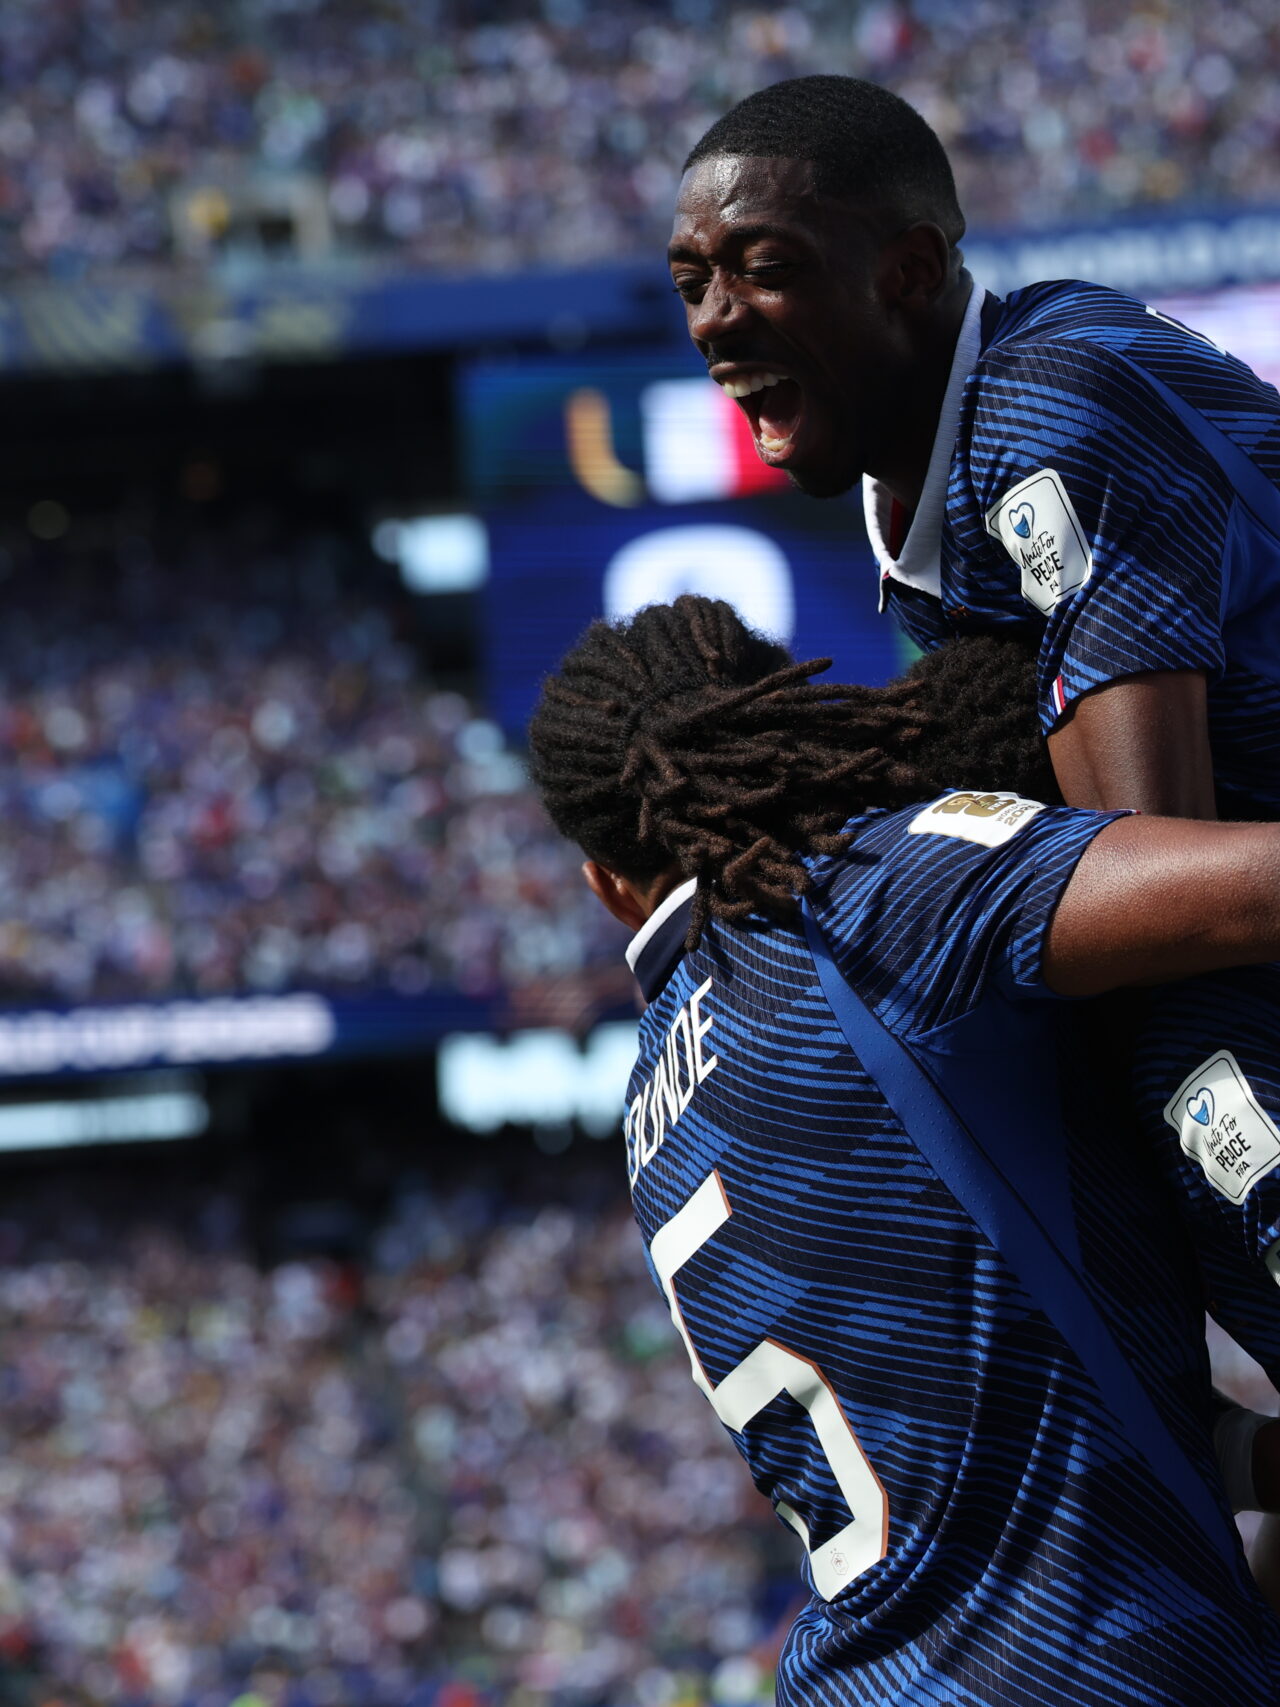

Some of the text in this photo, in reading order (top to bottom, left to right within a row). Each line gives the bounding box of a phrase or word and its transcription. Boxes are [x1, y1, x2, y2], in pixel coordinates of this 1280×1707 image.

[1037, 530, 1056, 554] For
[625, 976, 718, 1190] OUNDE
[1203, 1113, 1238, 1157] Unite For
[1215, 1132, 1252, 1173] PEACE
[1235, 1160, 1251, 1178] FIFA
[650, 1167, 889, 1603] 5
